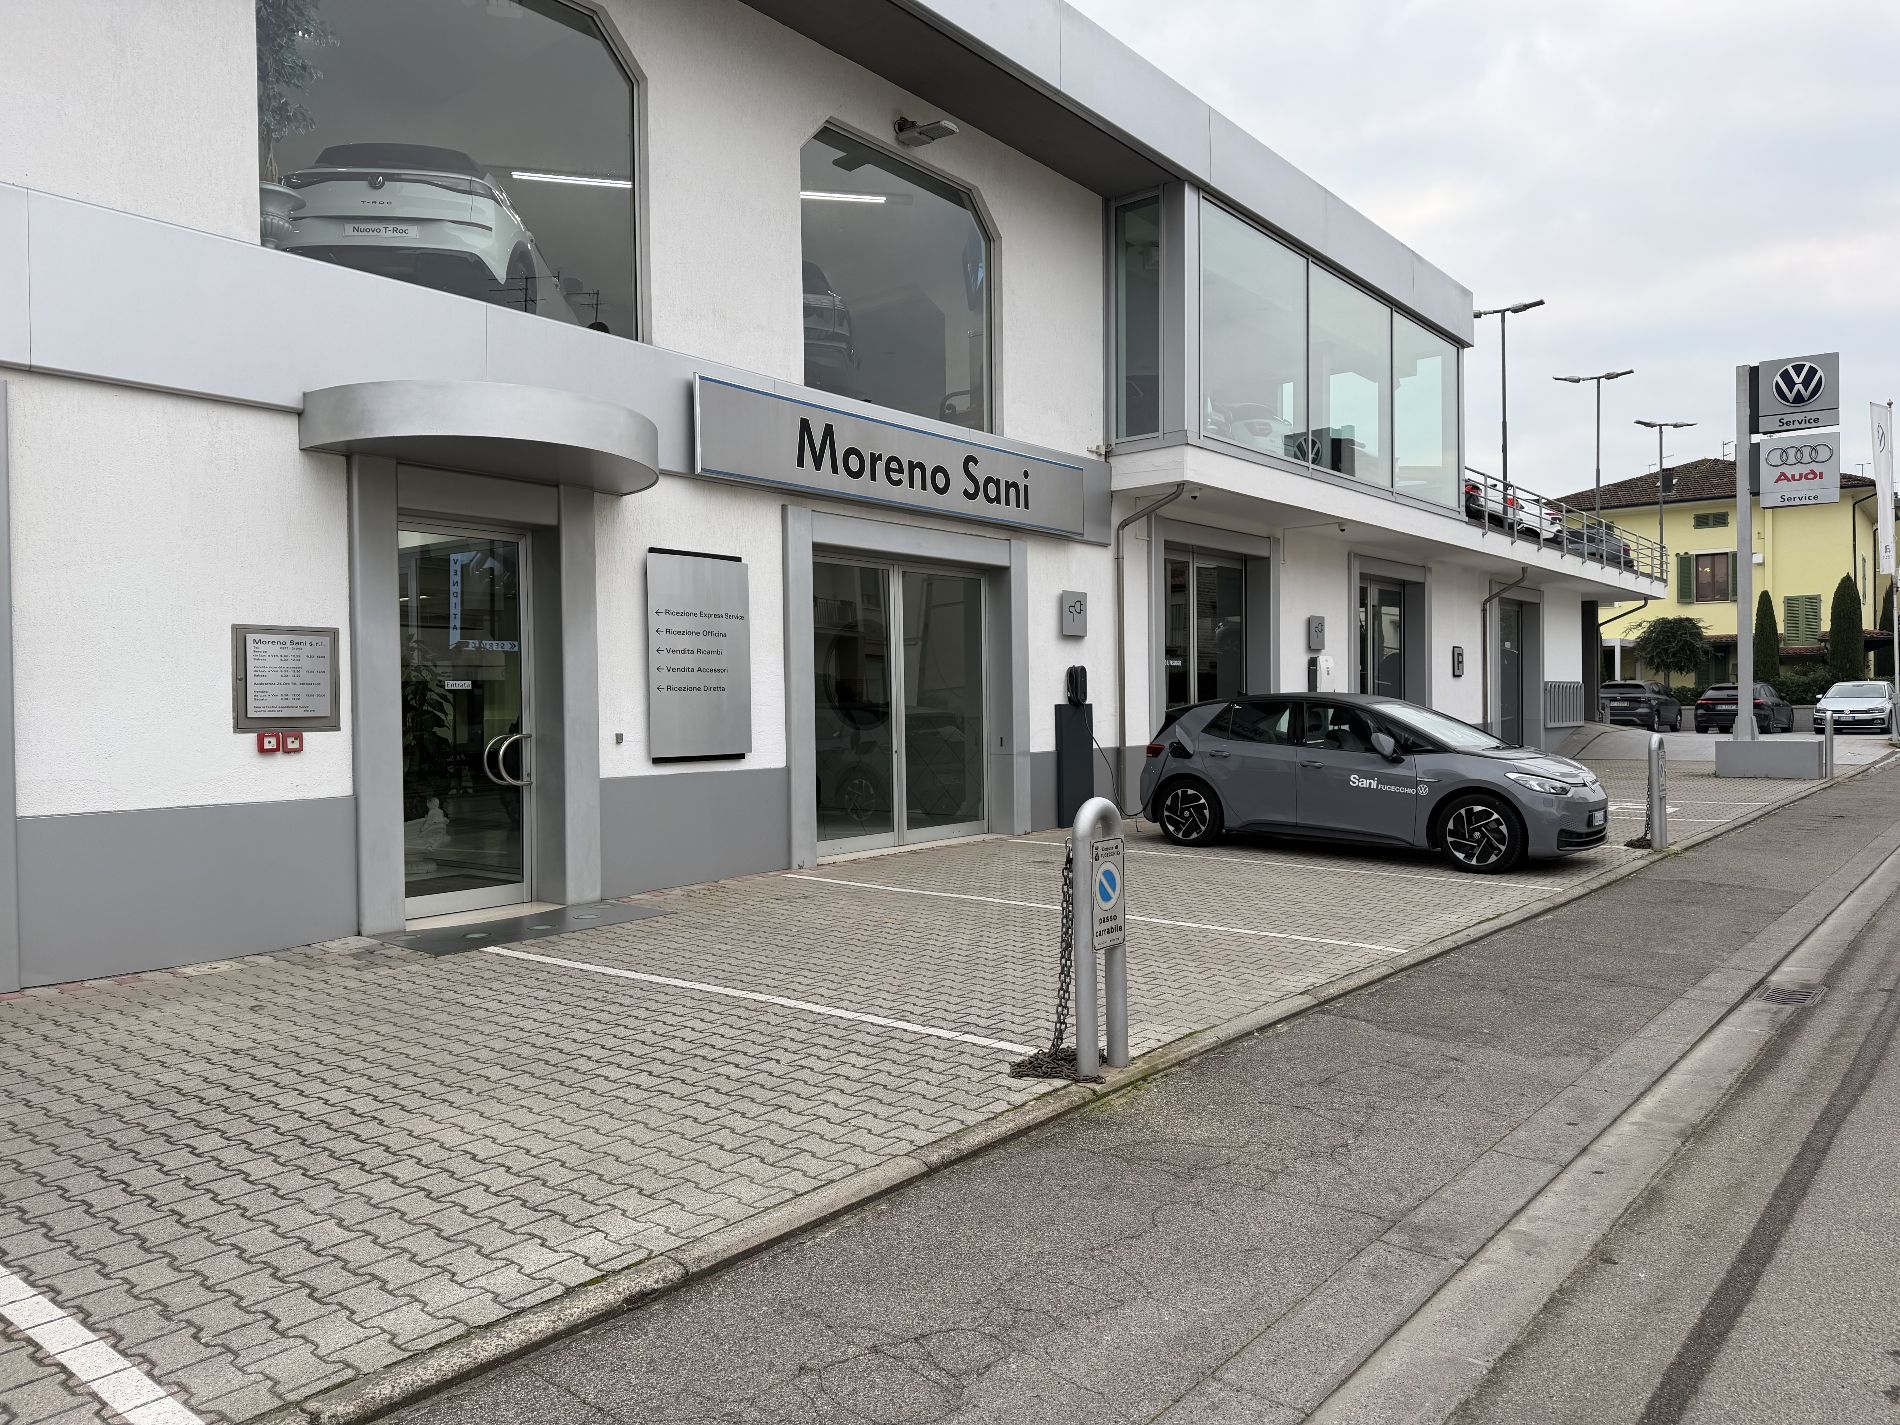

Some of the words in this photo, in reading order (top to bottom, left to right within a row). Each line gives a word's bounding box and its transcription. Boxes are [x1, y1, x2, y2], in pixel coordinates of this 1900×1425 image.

[352, 226, 382, 234] Nuovo
[382, 226, 409, 235] T-Roc
[1778, 416, 1820, 427] Service
[795, 416, 951, 496] Moreno
[961, 454, 1030, 510] Sani
[1774, 469, 1824, 484] Audi
[1780, 491, 1819, 503] Service
[664, 608, 698, 618] Ricezione
[700, 610, 724, 620] Express
[724, 612, 745, 621] Service
[666, 628, 701, 637] Ricezione
[702, 629, 727, 638] Officina
[252, 638, 287, 646] Moreno
[289, 639, 307, 647] Sani
[696, 648, 724, 656] Ricambi
[696, 666, 729, 674] Accessori
[446, 681, 471, 689] Entrata
[666, 684, 702, 692] Ricezione
[1349, 774, 1378, 789] Sani
[1378, 784, 1416, 795] FUCECCHIO
[1098, 914, 1118, 926] passo
[1095, 924, 1123, 938] carrabile
